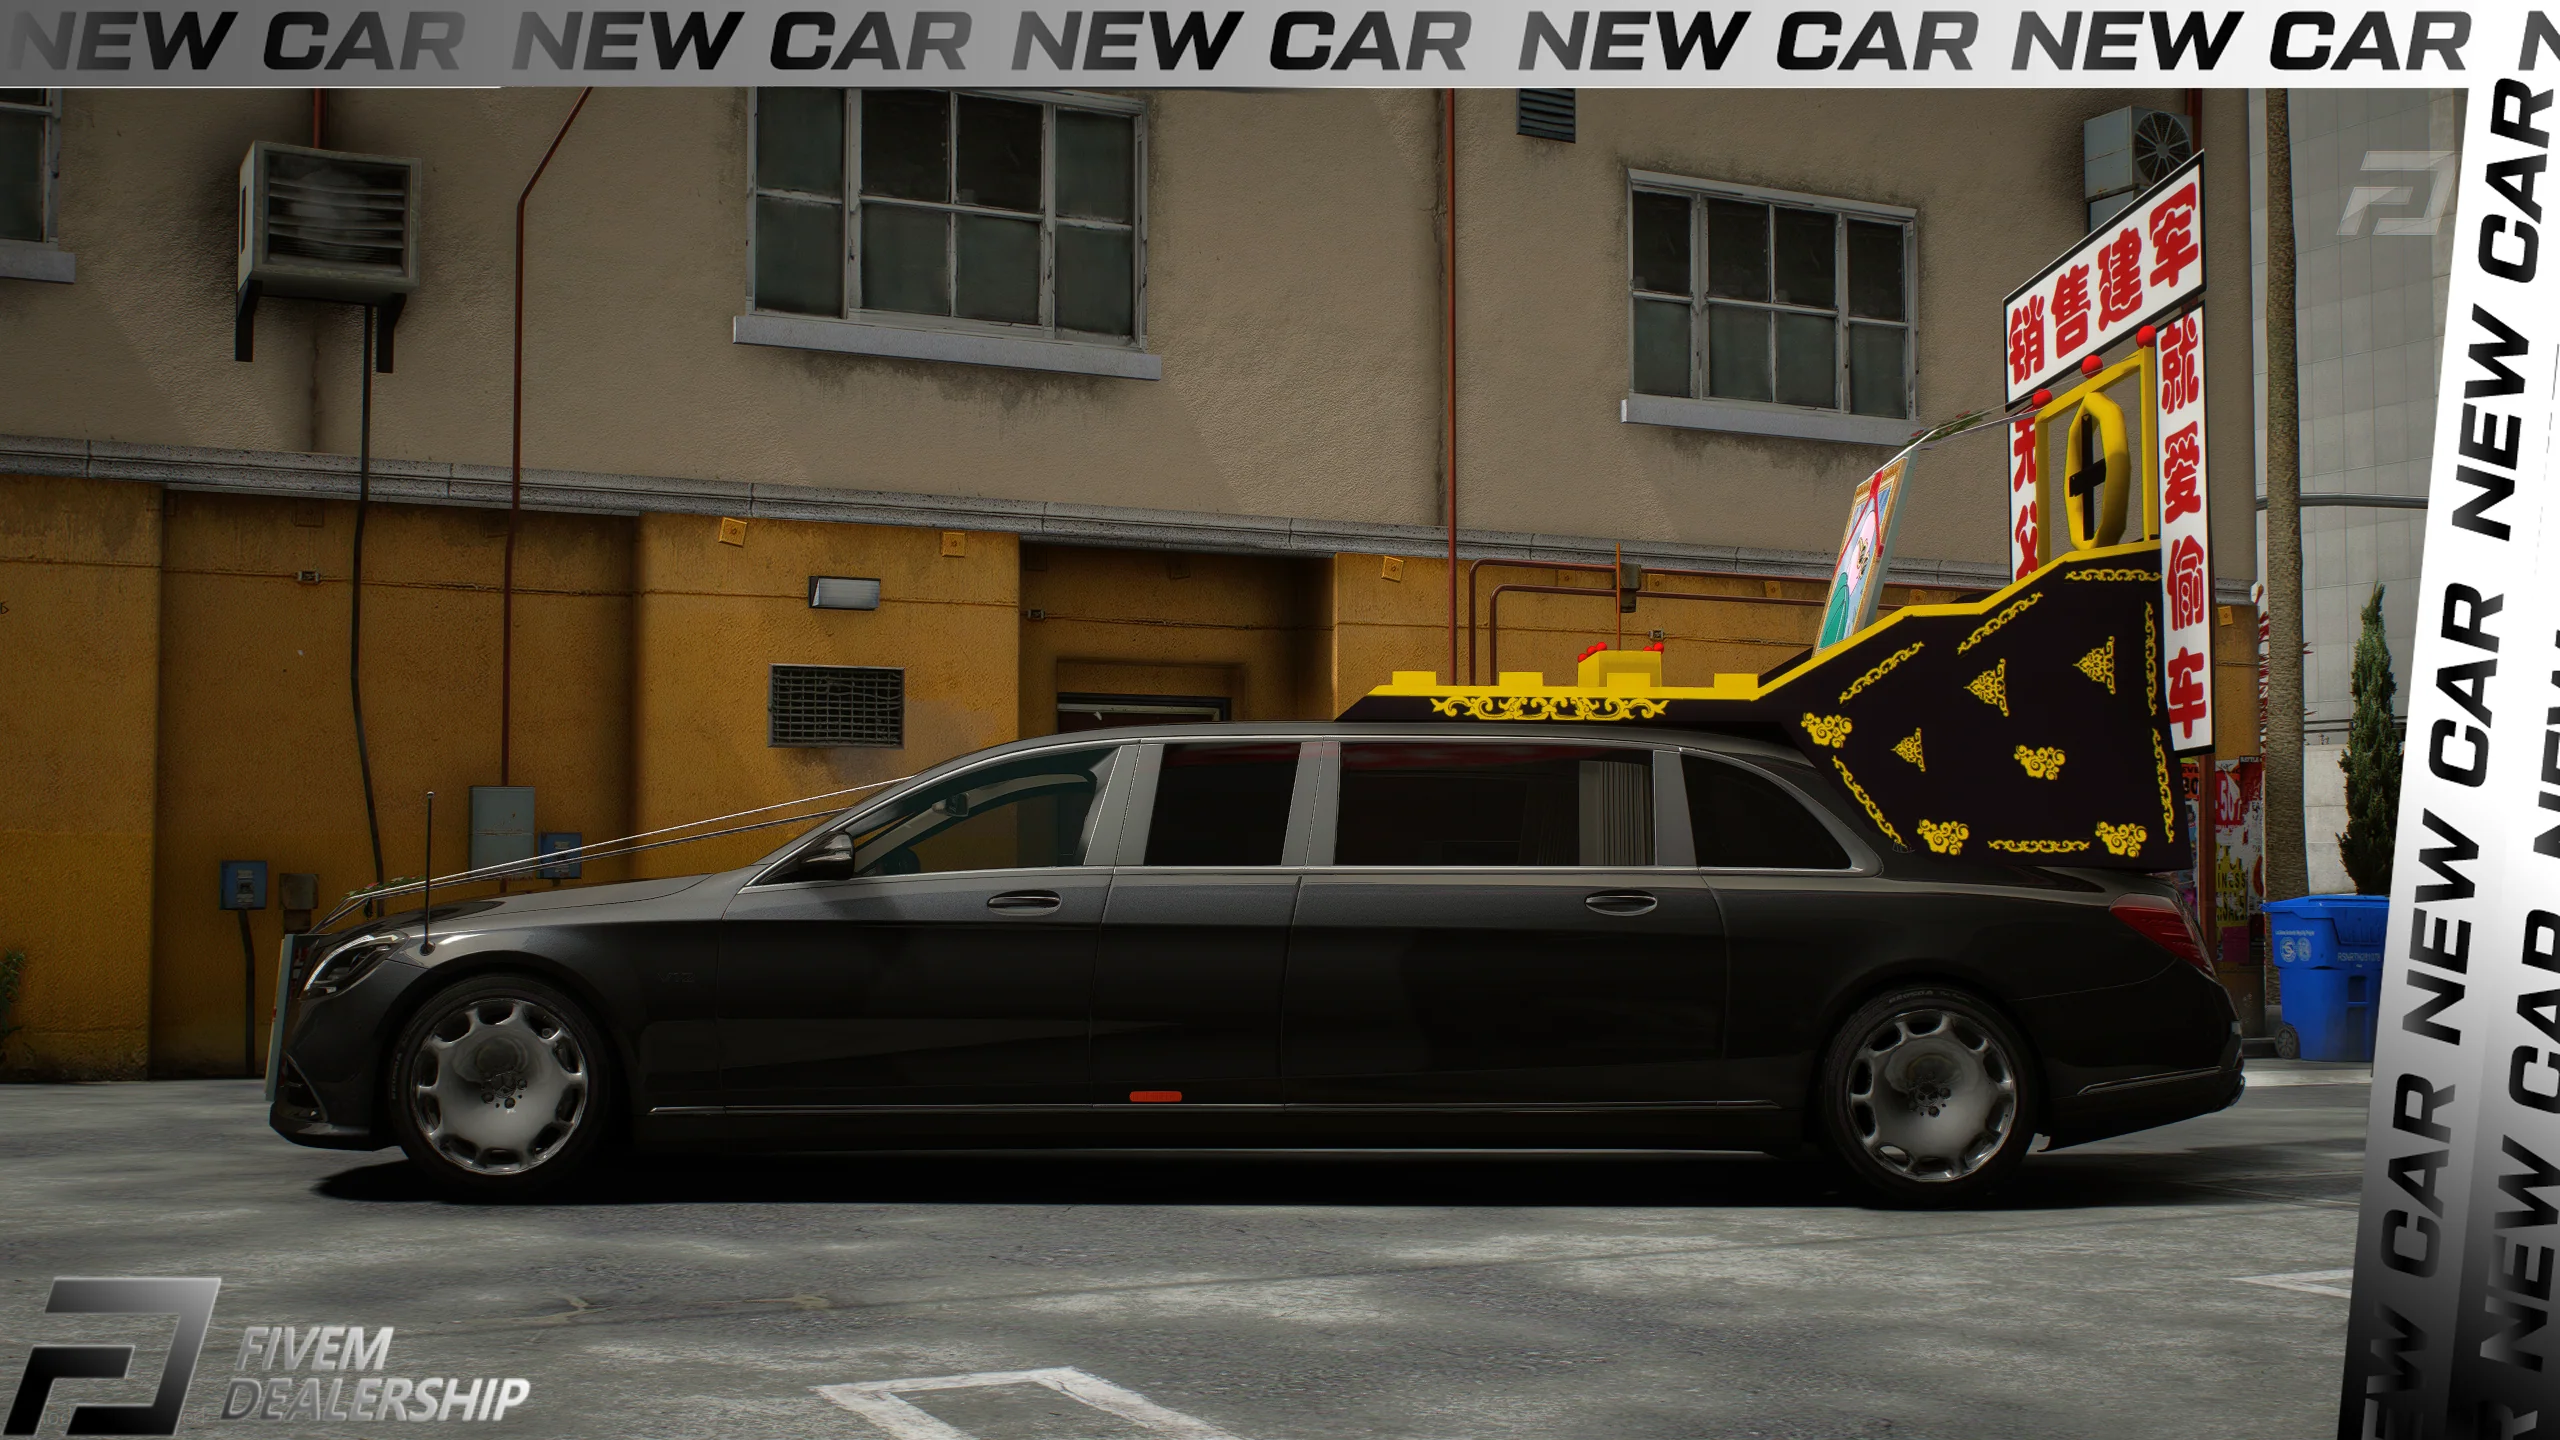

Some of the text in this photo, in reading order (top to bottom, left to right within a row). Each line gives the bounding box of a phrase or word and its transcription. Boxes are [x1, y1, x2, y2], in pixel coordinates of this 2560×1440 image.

[2008, 181, 2199, 385] 销售建军
[2160, 312, 2207, 740] 就爱偷车
